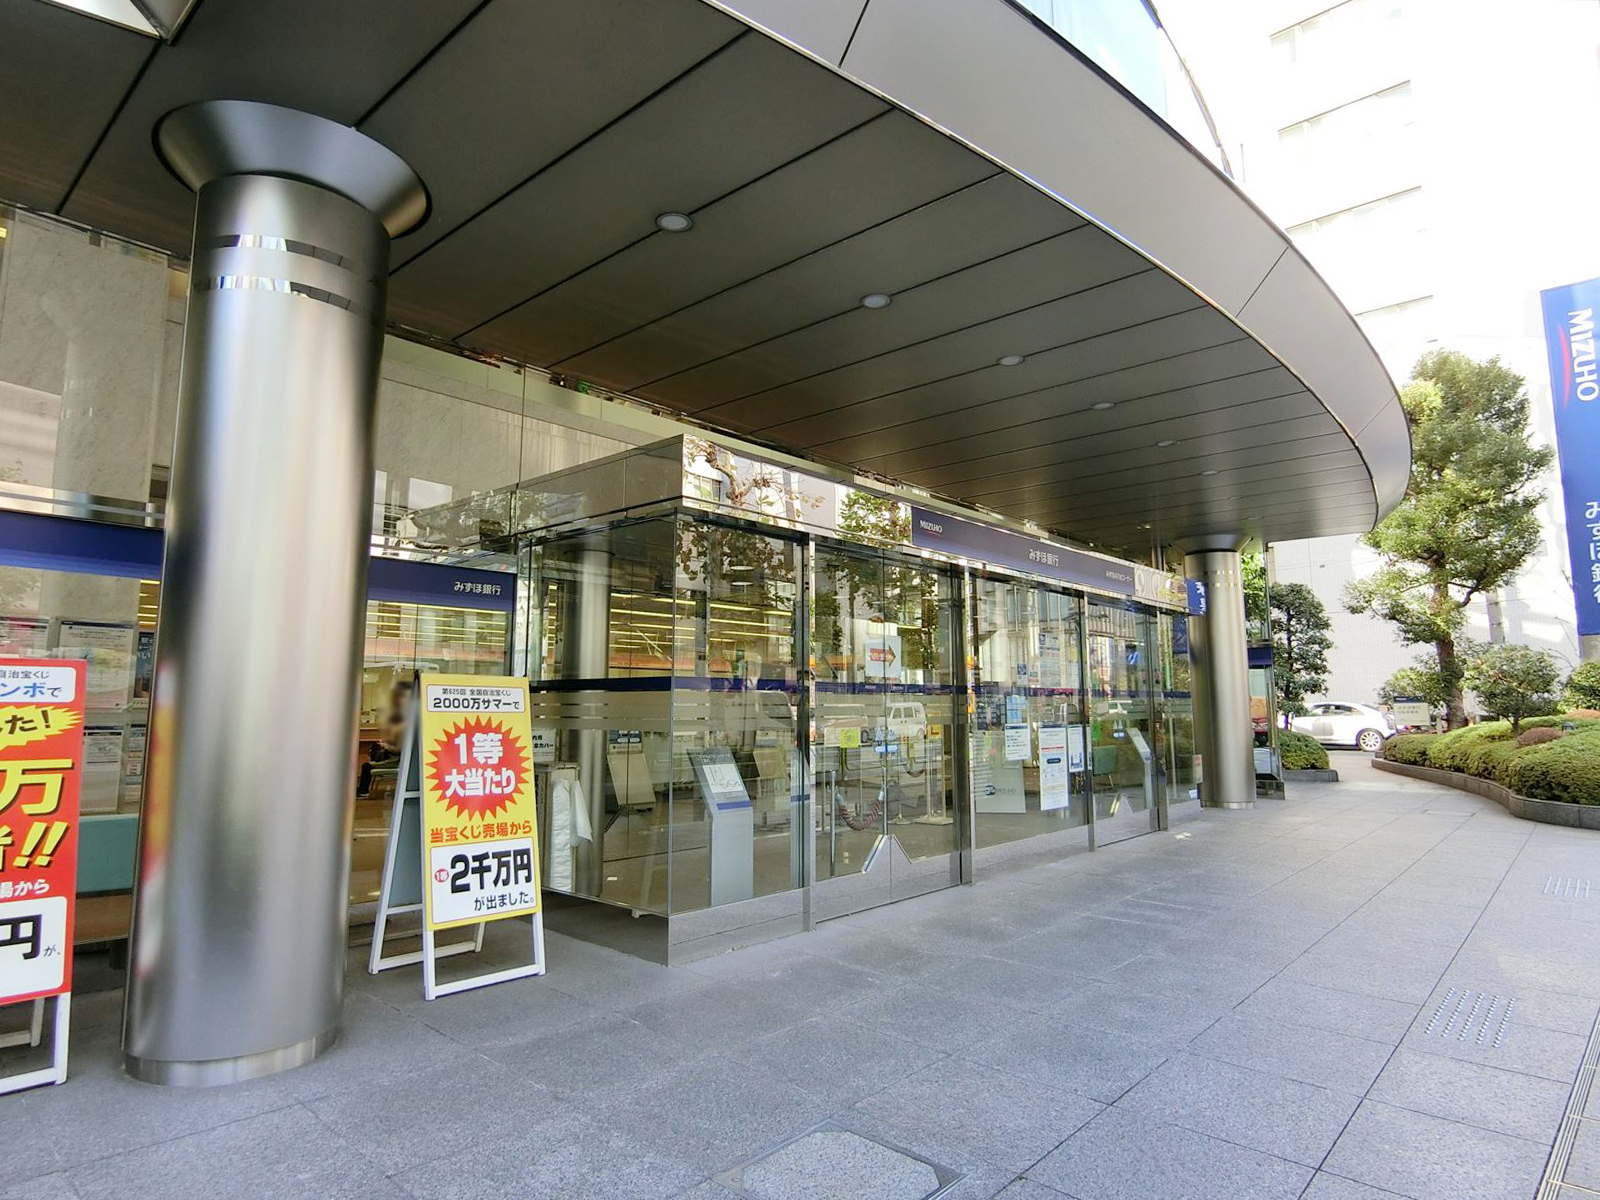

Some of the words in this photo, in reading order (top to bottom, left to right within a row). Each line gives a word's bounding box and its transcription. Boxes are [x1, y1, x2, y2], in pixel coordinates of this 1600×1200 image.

[1567, 308, 1600, 402] MIZUHO
[919, 520, 943, 533] MIZUHO
[1029, 549, 1059, 567] みずほ銀行
[453, 581, 501, 596] みずほ銀行
[469, 688, 511, 696] 全国自治宝くじ
[433, 697, 520, 710] 2000万サマーで
[0, 709, 51, 735] た!
[454, 732, 503, 765] 1等
[445, 767, 516, 798] 大当たり
[430, 820, 532, 843] 当宝くじ売場から
[450, 848, 532, 894] 2千万円
[474, 891, 534, 911] が出ました。
